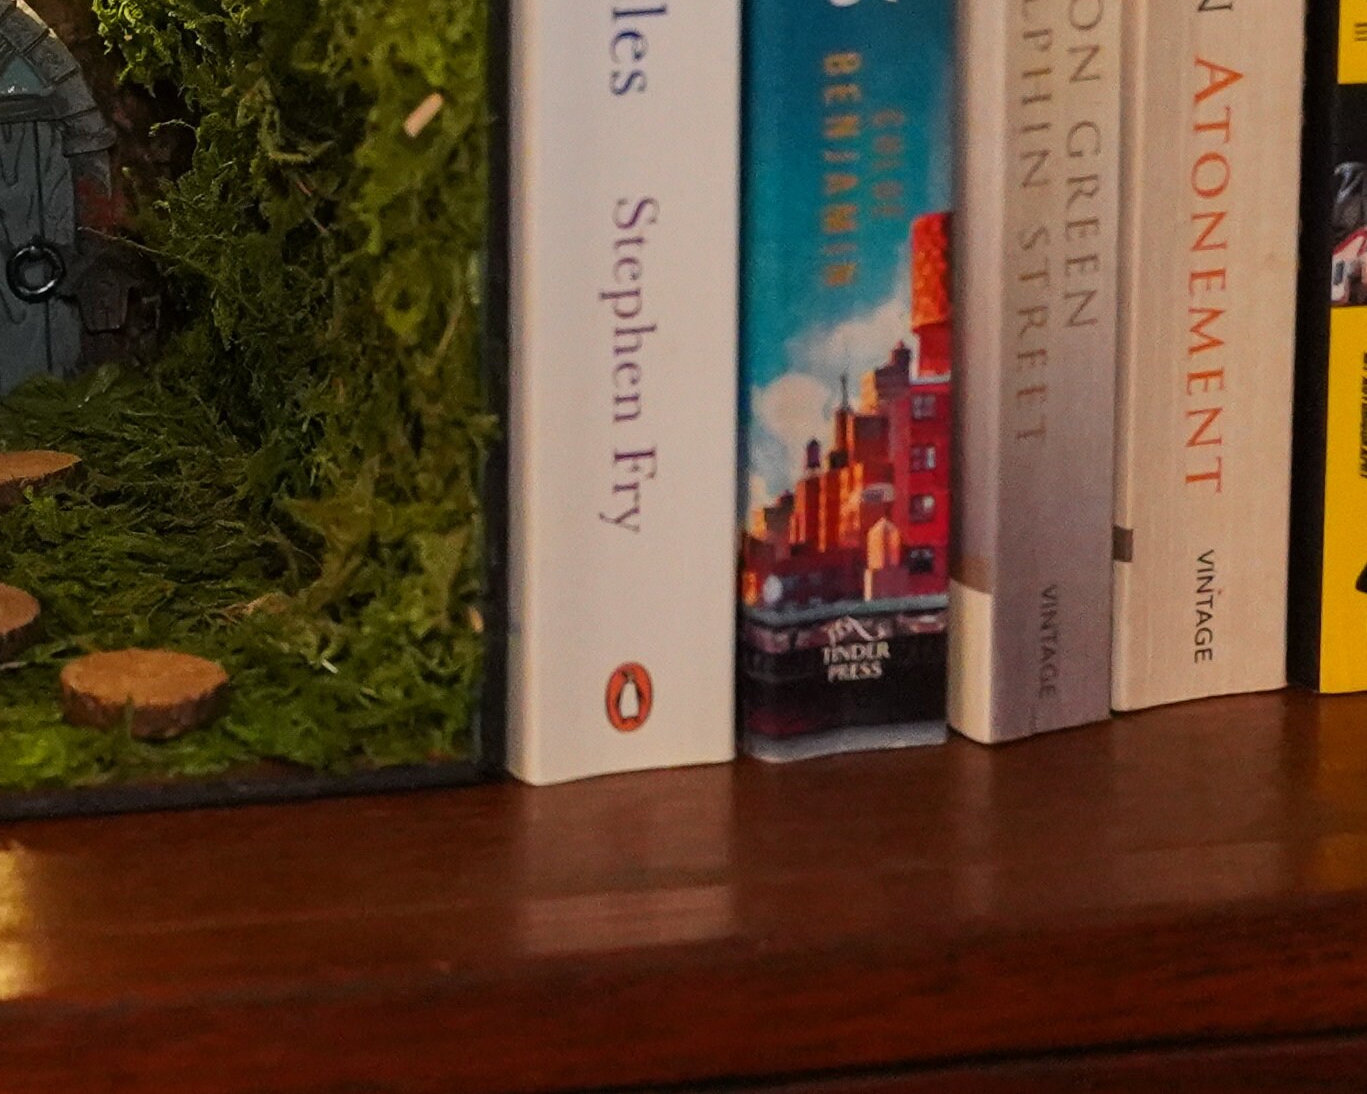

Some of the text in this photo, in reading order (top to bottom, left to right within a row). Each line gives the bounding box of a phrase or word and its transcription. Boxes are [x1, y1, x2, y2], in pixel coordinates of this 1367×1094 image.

[599, 195, 660, 423] Stephen
[1063, 119, 1103, 329] GREEN
[1184, 56, 1244, 494] ATONEMENT
[1015, 225, 1051, 443] STREET
[599, 445, 659, 533] Fry
[1039, 583, 1060, 700] VINTAGE
[1194, 548, 1217, 665] VINTAGE
